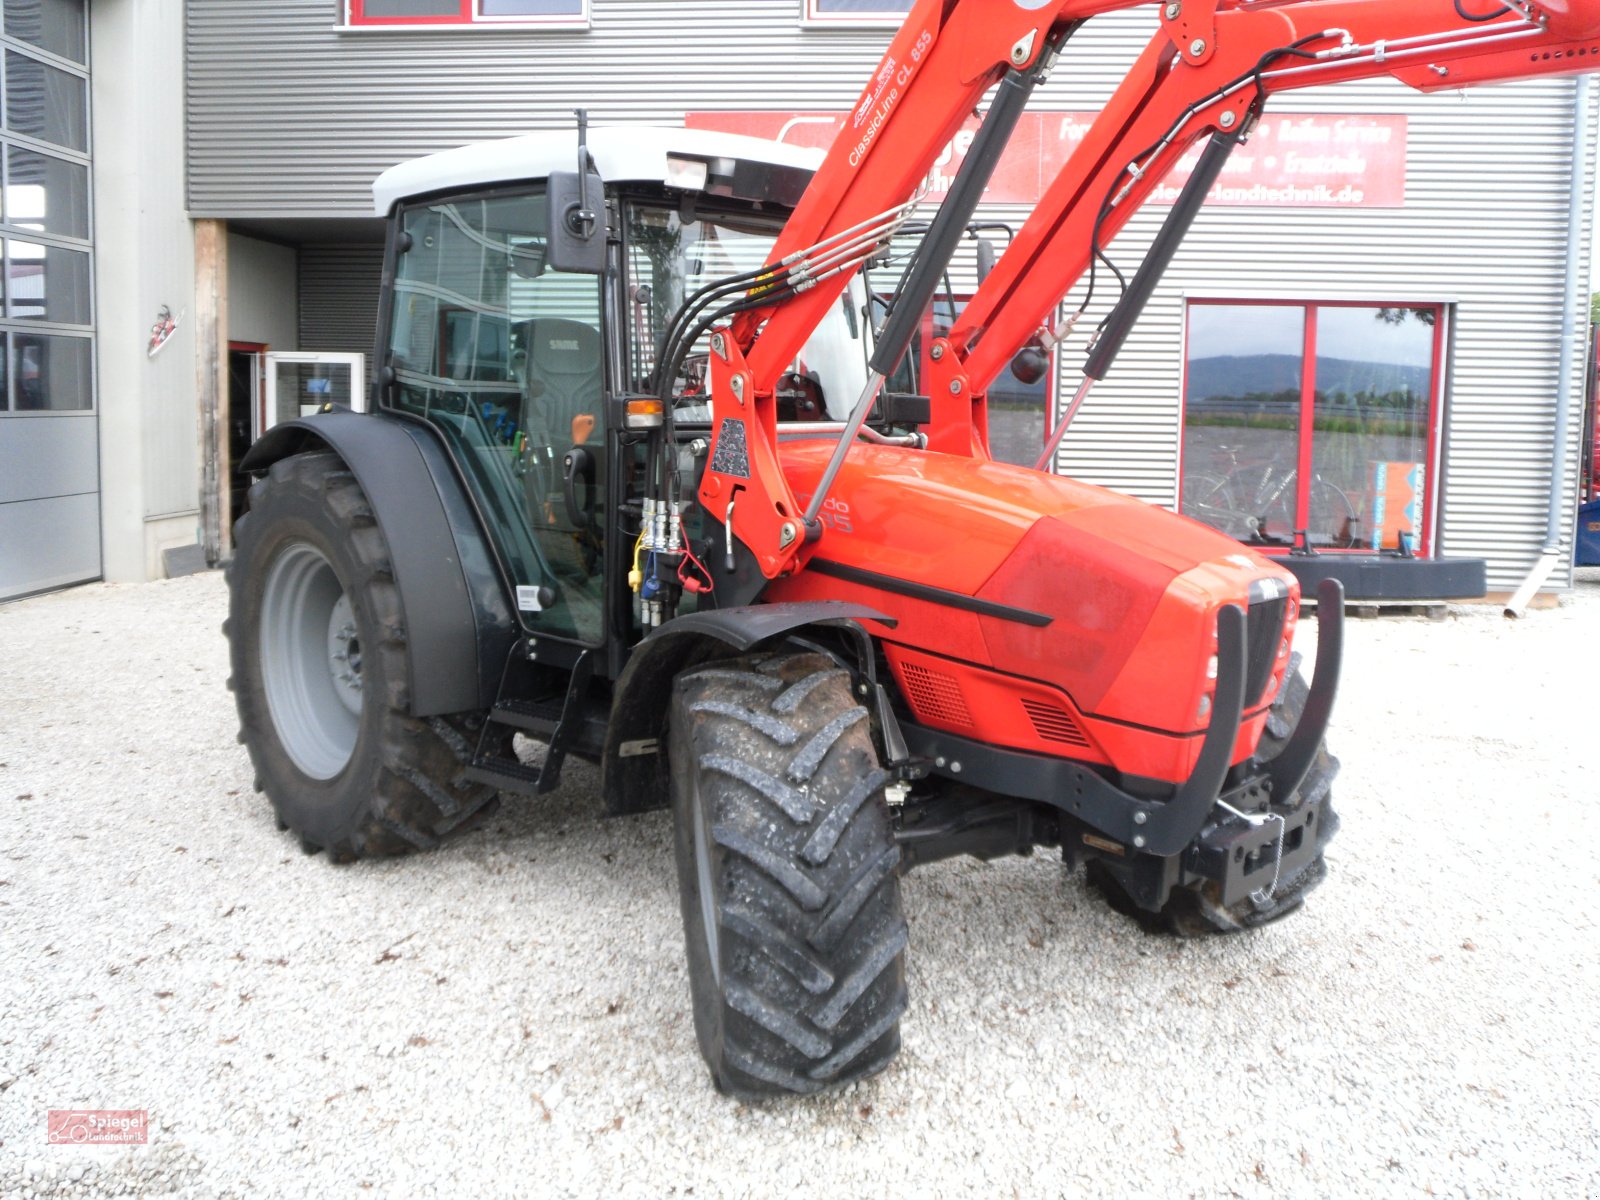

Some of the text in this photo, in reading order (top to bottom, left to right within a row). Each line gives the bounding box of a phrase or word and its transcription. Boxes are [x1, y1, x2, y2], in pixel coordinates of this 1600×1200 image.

[848, 88, 898, 167] ClassicLine
[896, 64, 914, 86] CL
[911, 29, 932, 62] 855
[1059, 117, 1092, 140] For
[1333, 119, 1392, 143] Service
